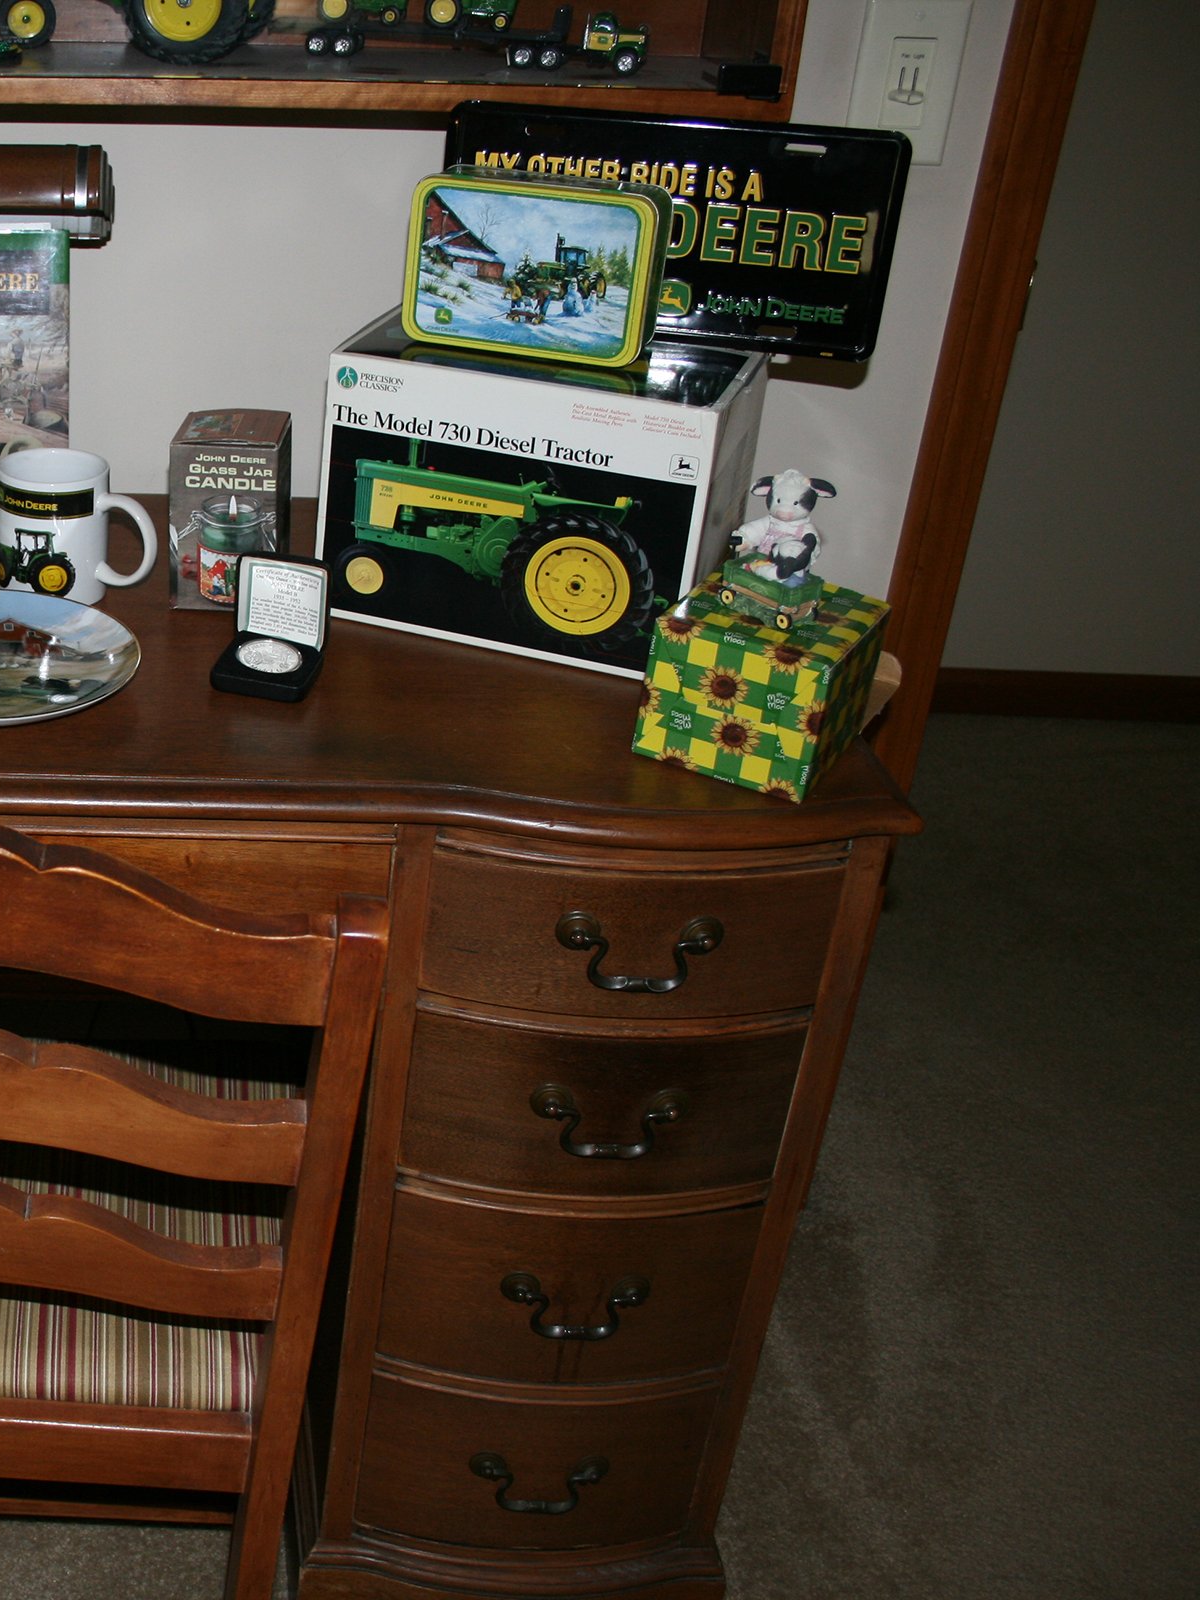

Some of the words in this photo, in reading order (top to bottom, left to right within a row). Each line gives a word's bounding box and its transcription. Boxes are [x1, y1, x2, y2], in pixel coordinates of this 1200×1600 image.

[527, 153, 621, 181] OTHER
[629, 162, 698, 197] RIDE
[705, 167, 736, 199] IS
[741, 169, 764, 202] A
[666, 199, 867, 275] DEERE
[697, 290, 762, 318] JOHN
[765, 296, 845, 325] DEERE
[360, 372, 404, 386] PRECISION
[360, 380, 398, 393] CLASSICS
[332, 403, 368, 426] The
[374, 411, 434, 437] Model
[439, 421, 471, 443] 730
[476, 427, 536, 454] Diesel
[541, 438, 613, 467] Tractor
[195, 453, 226, 462] JOHN
[230, 455, 266, 464] DEERE
[189, 463, 237, 475] GLASS
[243, 466, 273, 477] JAR
[185, 475, 276, 492] CANDLE
[5, 495, 24, 508] JOHN
[25, 500, 58, 512] DEERE
[429, 493, 454, 502] JOHN
[457, 498, 488, 508] DEERE
[767, 701, 785, 711] Moo
